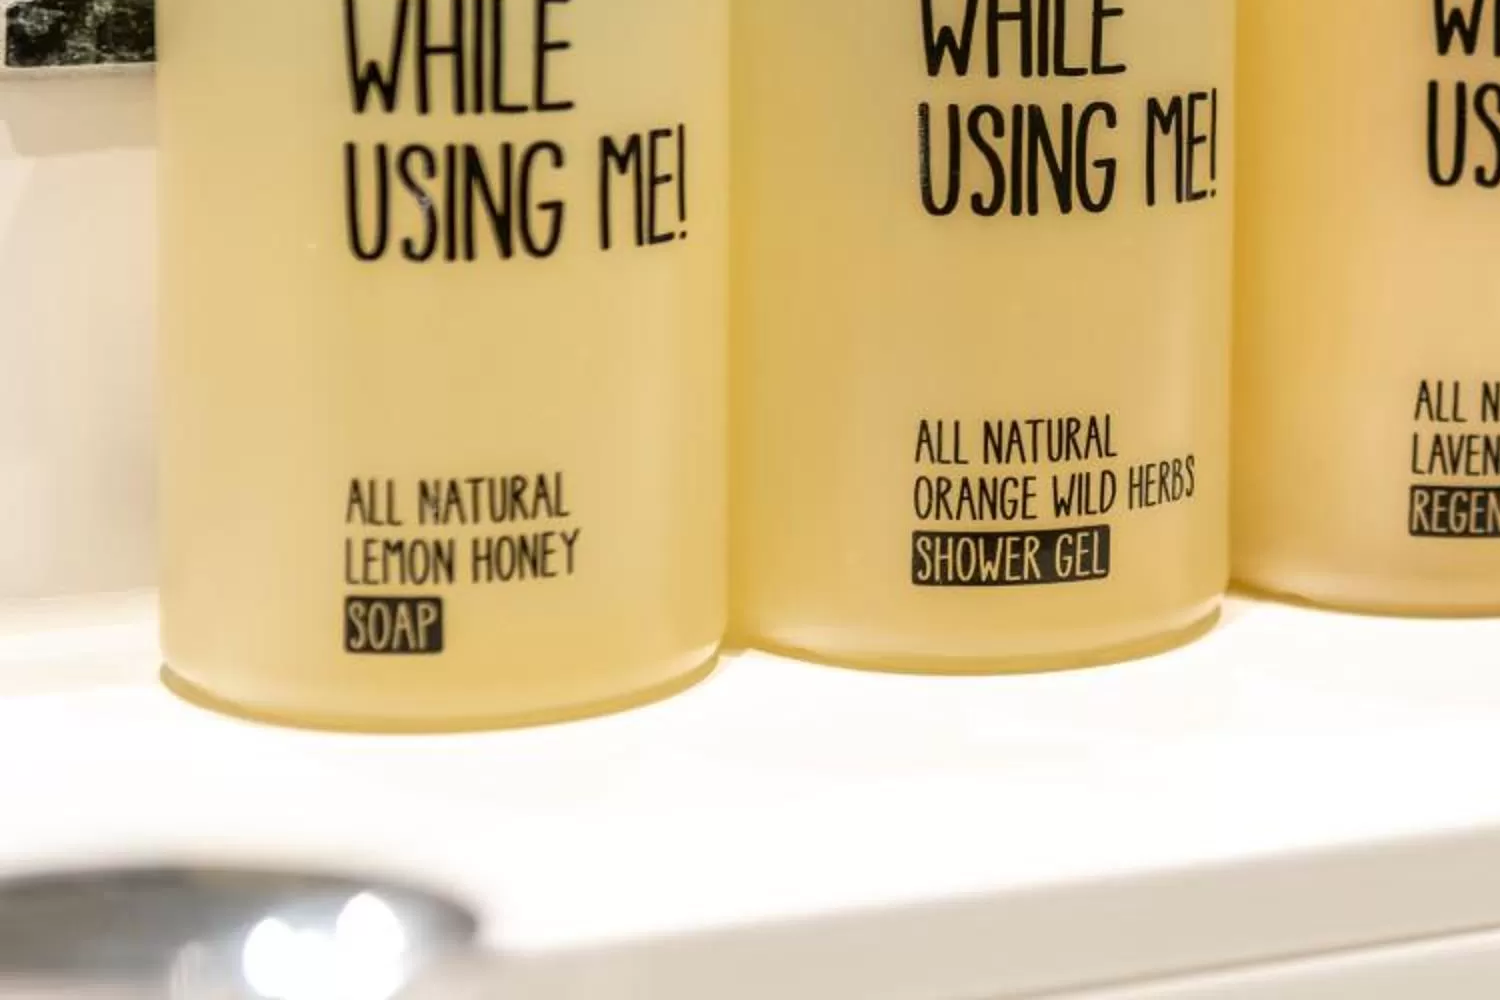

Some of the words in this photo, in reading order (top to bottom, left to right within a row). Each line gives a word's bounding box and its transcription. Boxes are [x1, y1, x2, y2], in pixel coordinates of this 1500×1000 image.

[919, 101, 1117, 216] USING
[1146, 87, 1217, 207] ME!
[344, 142, 564, 262] USING
[600, 123, 688, 250] ME!
[1414, 379, 1467, 423] ALL
[914, 418, 970, 465] ALL
[982, 413, 1118, 464] NATURAL
[345, 477, 403, 526] ALL
[418, 471, 571, 526] NATURAL
[913, 475, 1038, 521] ORANGE
[1052, 469, 1117, 518] WILD
[1127, 453, 1195, 511] HERBS
[345, 537, 455, 586] LEMON
[471, 527, 581, 584] HONEY
[916, 534, 1041, 582] SHOWER
[1055, 529, 1106, 578] GEL
[348, 601, 437, 650] SOAP
